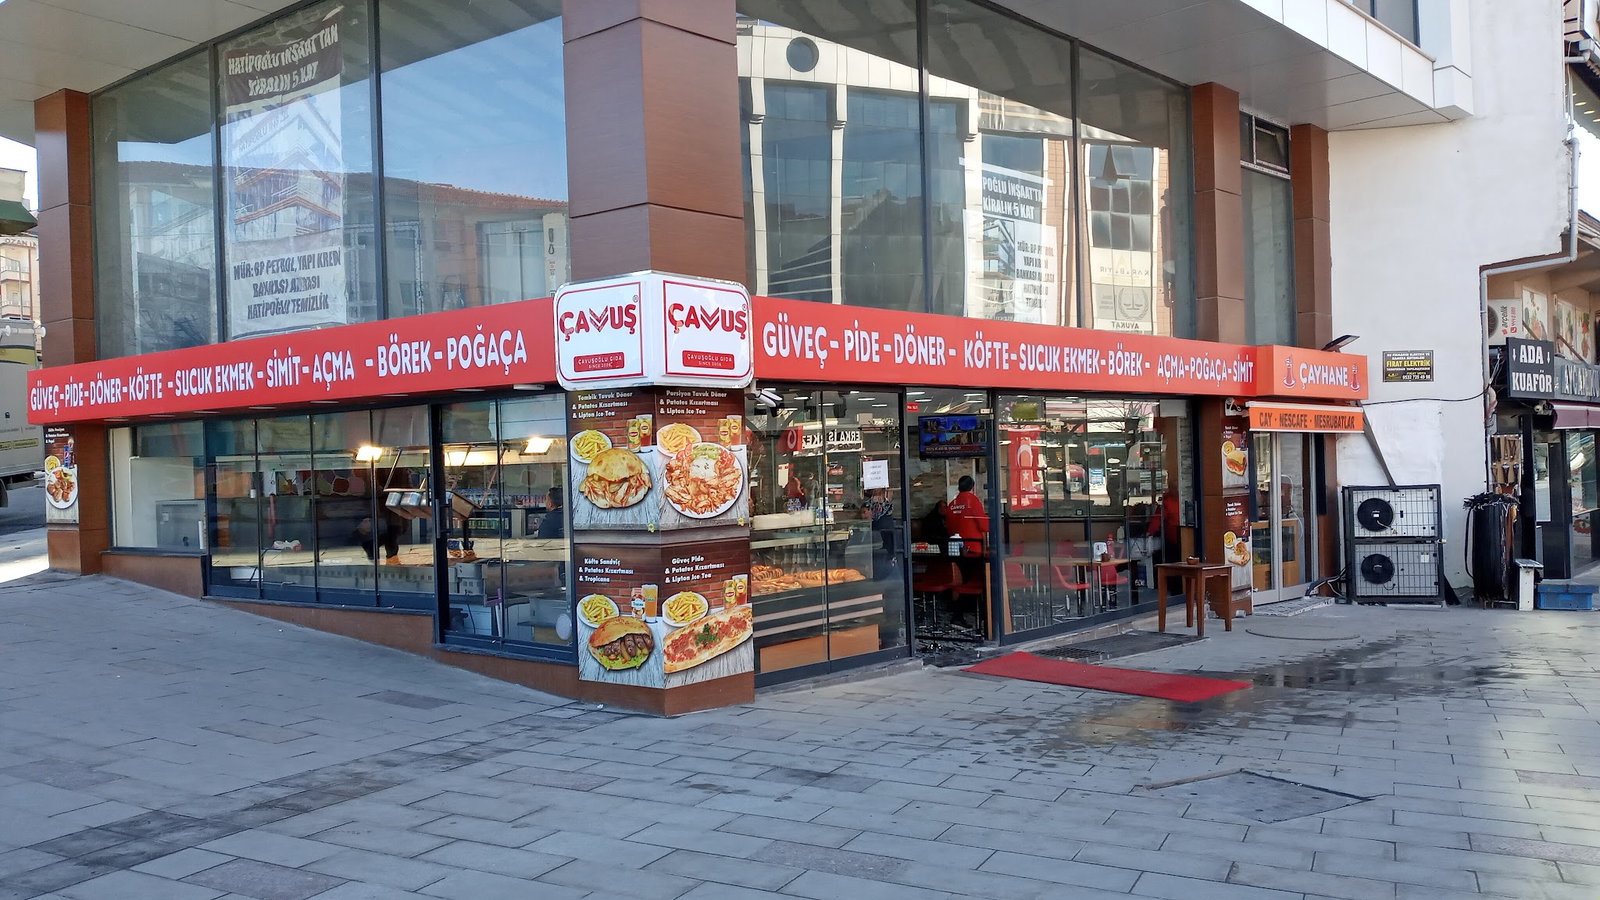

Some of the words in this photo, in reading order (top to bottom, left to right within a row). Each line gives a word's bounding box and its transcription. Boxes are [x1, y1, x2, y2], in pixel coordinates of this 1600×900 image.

[982, 176, 1007, 194] POĞLU
[1008, 180, 1043, 202] İNŞAAT'TA
[983, 195, 1013, 215] KİRALIK
[1013, 202, 1020, 217] 5
[1020, 203, 1035, 219] KAT
[298, 254, 315, 271] YAPI
[318, 246, 341, 268] KREDİ
[247, 298, 291, 319] HATİPOĞLU
[291, 292, 329, 313] TEMİZLİK
[559, 304, 637, 341] ÇAVUŞ
[668, 303, 747, 339] ÇAVUŞ
[762, 312, 828, 369] GÜVEÇ
[844, 320, 880, 363] PİDE
[894, 324, 946, 366] DÖNER
[964, 331, 1009, 370] KÖFTE
[1019, 343, 1061, 373] SUCUK
[1063, 346, 1100, 375] EKMEK
[1108, 343, 1143, 377] BÖREK
[1157, 354, 1185, 385] AÇMA
[1190, 352, 1228, 388] POĞAÇA
[1232, 353, 1254, 383] SİMİT
[1403, 359, 1431, 367] ELEKTRİK
[1520, 344, 1544, 364] ADA
[30, 380, 59, 415] GÜVEÇ
[65, 376, 84, 408] PİDE
[89, 372, 121, 405] DÖNER
[129, 367, 162, 401] KÖFTE
[175, 367, 213, 397] SUCUK
[215, 362, 254, 393] EKMEK
[266, 347, 300, 388] SİMİT
[312, 350, 355, 391] AÇMA
[377, 333, 431, 377] BÖREK
[446, 324, 528, 375] POĞAÇA
[1299, 362, 1348, 389] ÇAYHANE
[1512, 369, 1552, 392] KUAFÖR
[671, 575, 690, 583] Lipton
